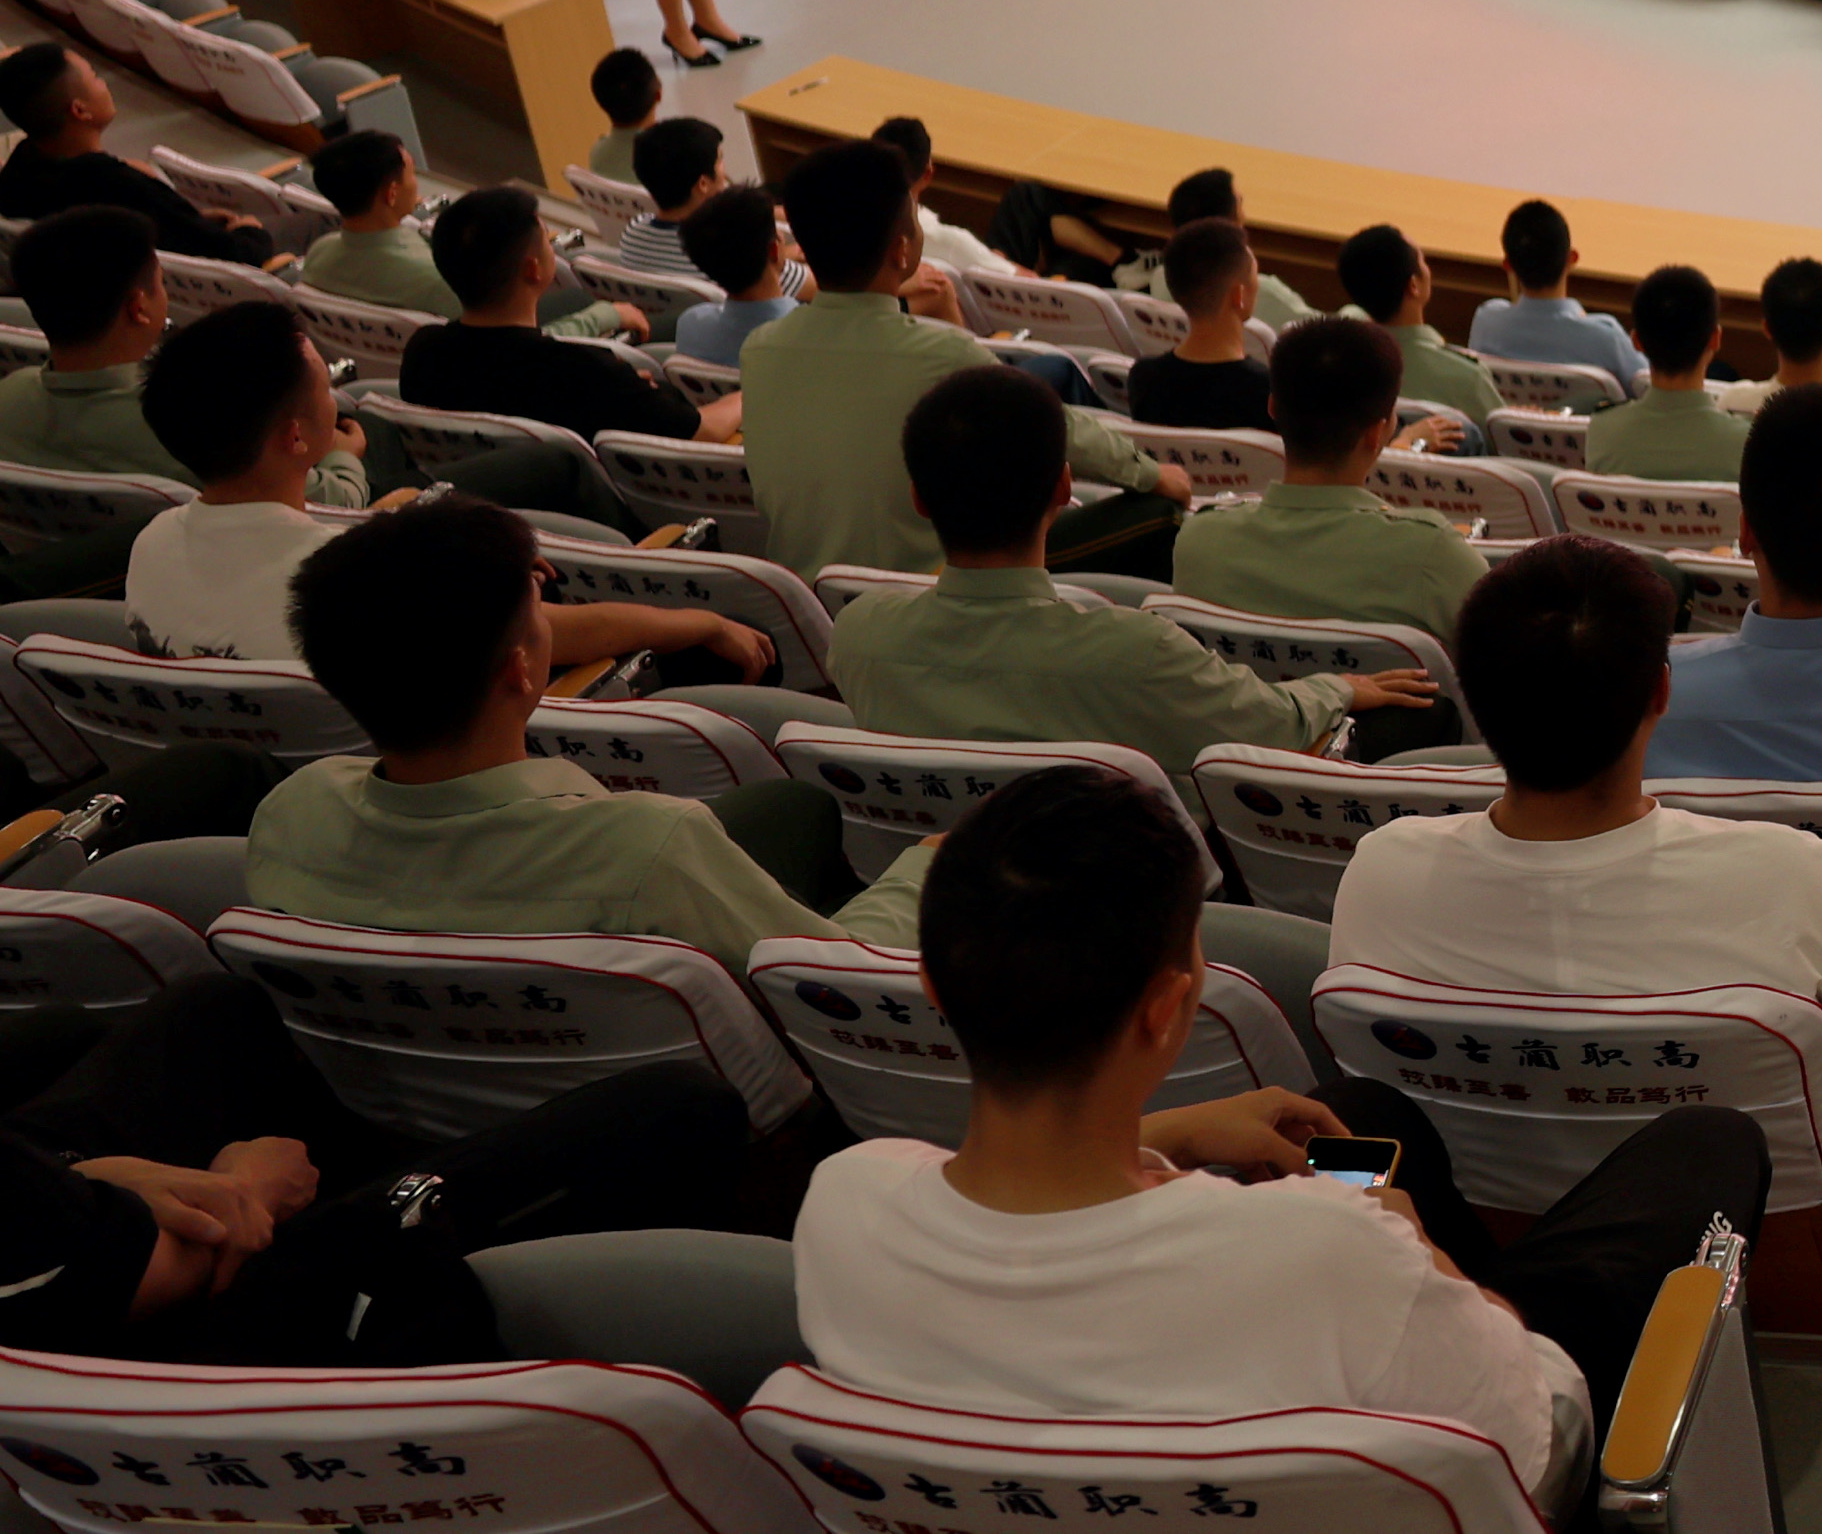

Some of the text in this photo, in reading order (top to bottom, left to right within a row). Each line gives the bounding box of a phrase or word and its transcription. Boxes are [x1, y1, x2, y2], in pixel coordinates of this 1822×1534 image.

[1455, 1034, 1701, 1071] 古蔺职高
[112, 1442, 466, 1489] 古蔺职高
[904, 1472, 1258, 1520] 古蔺职高
